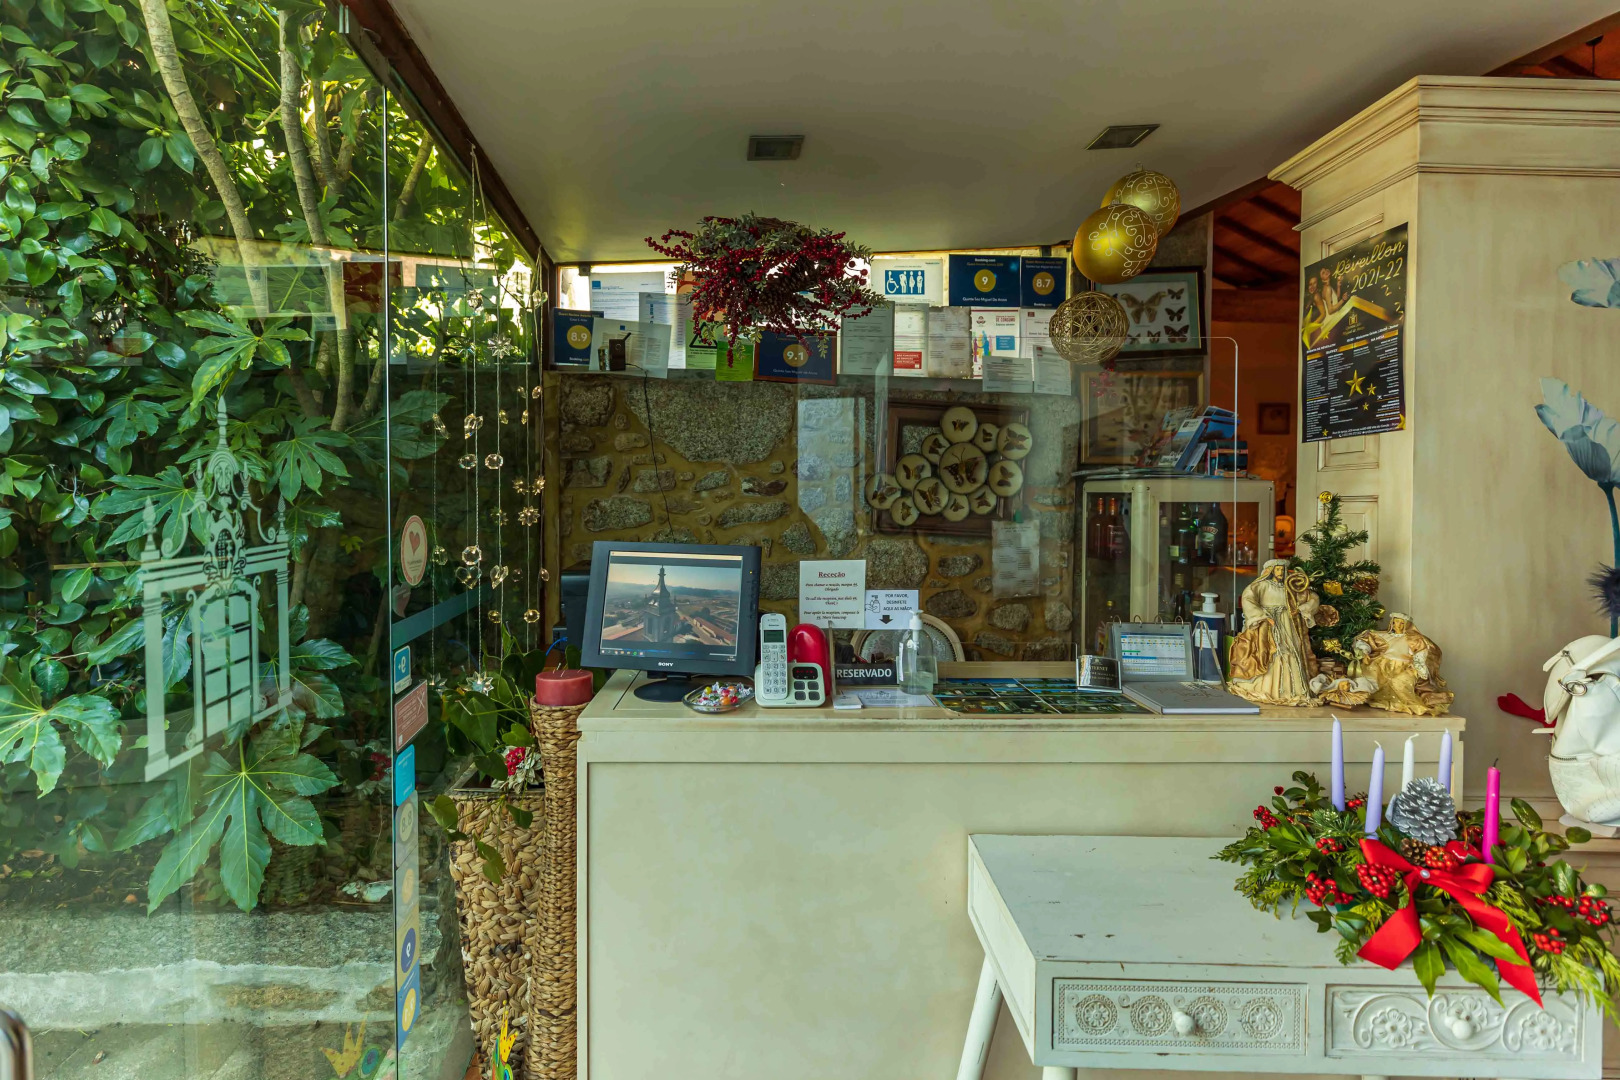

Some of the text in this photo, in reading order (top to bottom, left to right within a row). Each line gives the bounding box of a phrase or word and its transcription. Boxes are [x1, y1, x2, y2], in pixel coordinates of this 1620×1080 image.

[1332, 240, 1405, 279] Réveillon
[982, 276, 989, 285] 9
[1351, 257, 1403, 294] 2021-22
[1036, 278, 1051, 288] 8.7
[571, 332, 588, 342] 8.9
[786, 350, 804, 361] 9.1
[818, 571, 846, 579] Receção
[836, 668, 892, 678] RESERVADO
